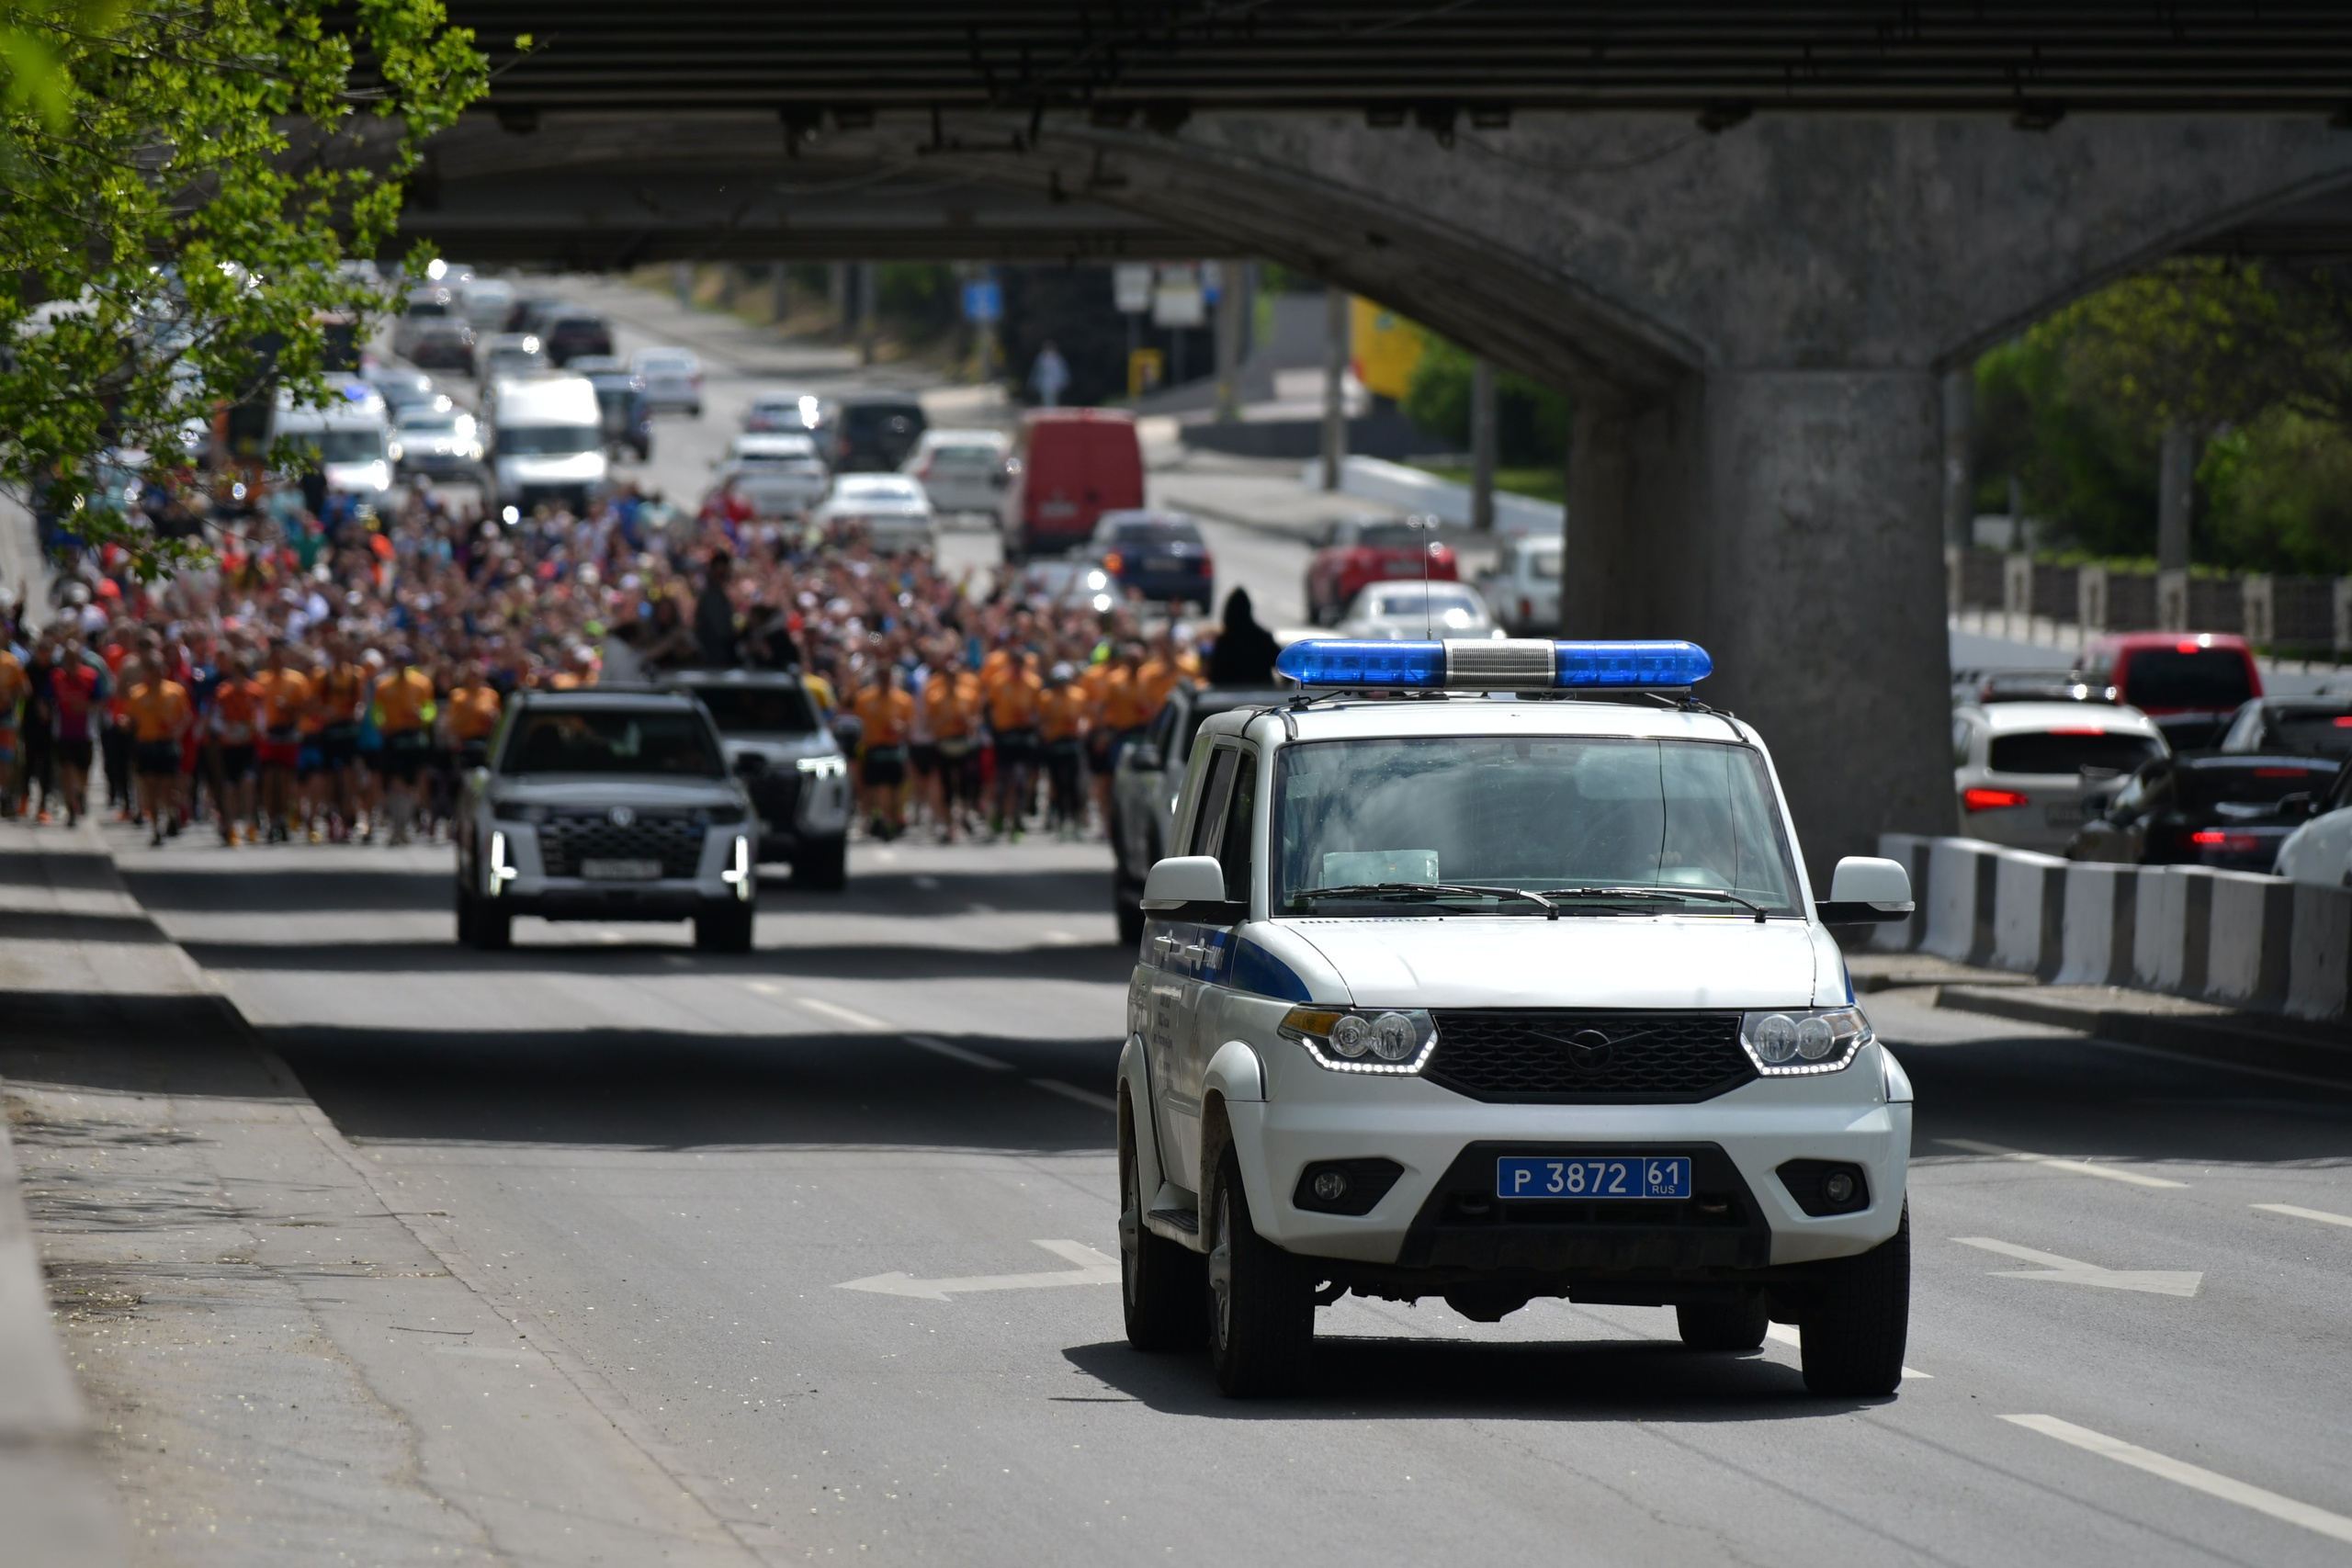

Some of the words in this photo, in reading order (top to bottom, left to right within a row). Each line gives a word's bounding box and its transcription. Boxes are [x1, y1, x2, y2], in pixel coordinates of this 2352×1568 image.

[1546, 1163, 1626, 1193] 3872
[1647, 1161, 1679, 1185] 61
[1652, 1185, 1675, 1194] RUS
